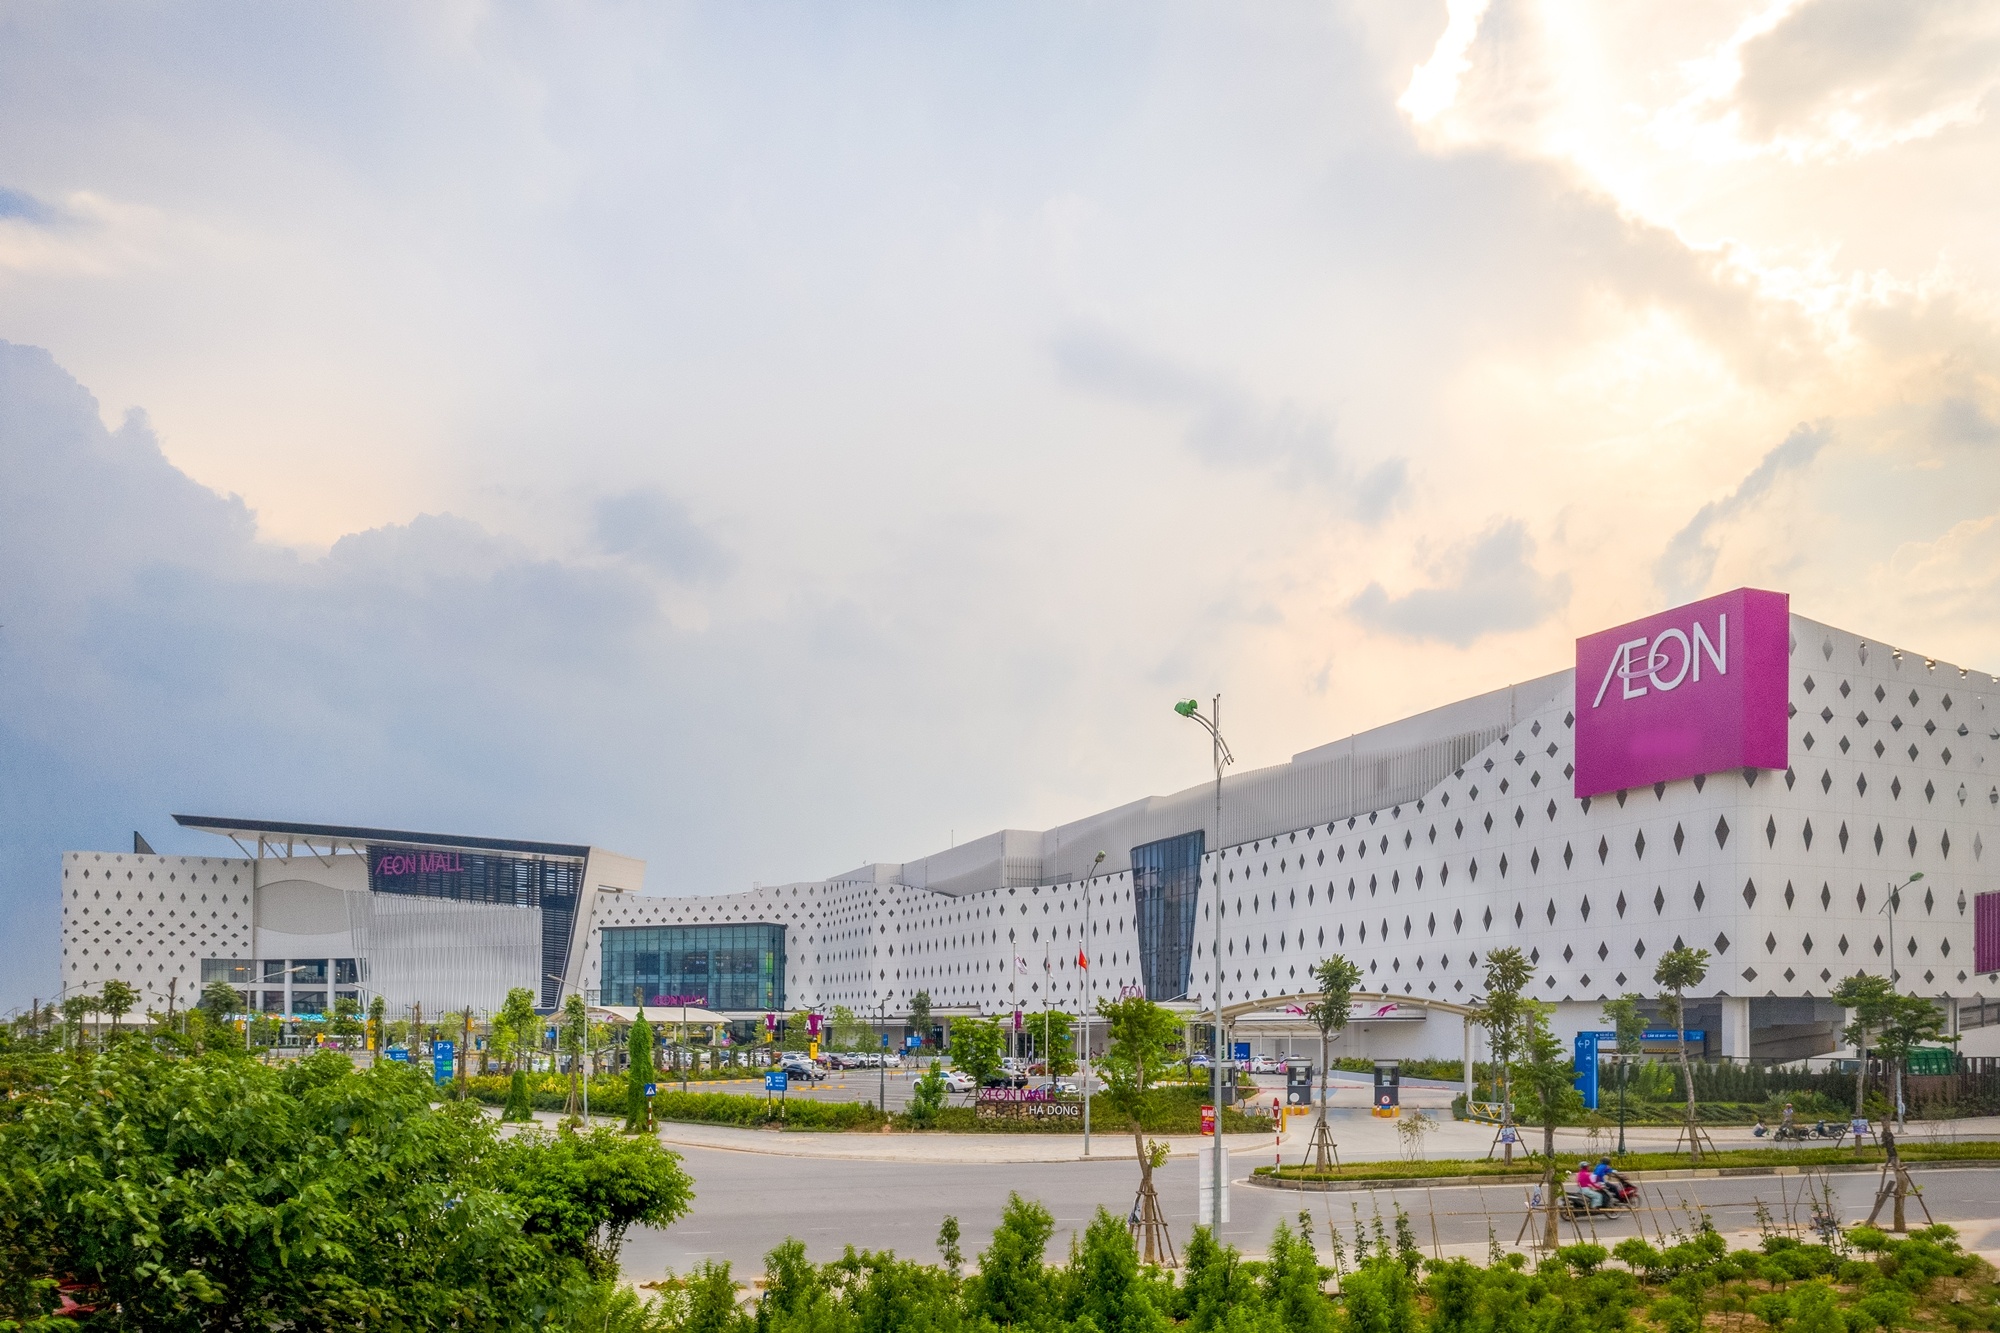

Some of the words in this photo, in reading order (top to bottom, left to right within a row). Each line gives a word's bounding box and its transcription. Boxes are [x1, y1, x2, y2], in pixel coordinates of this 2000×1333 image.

[420, 849, 465, 874] MALL
[437, 1042, 444, 1051] P
[1584, 1040, 1591, 1049] P
